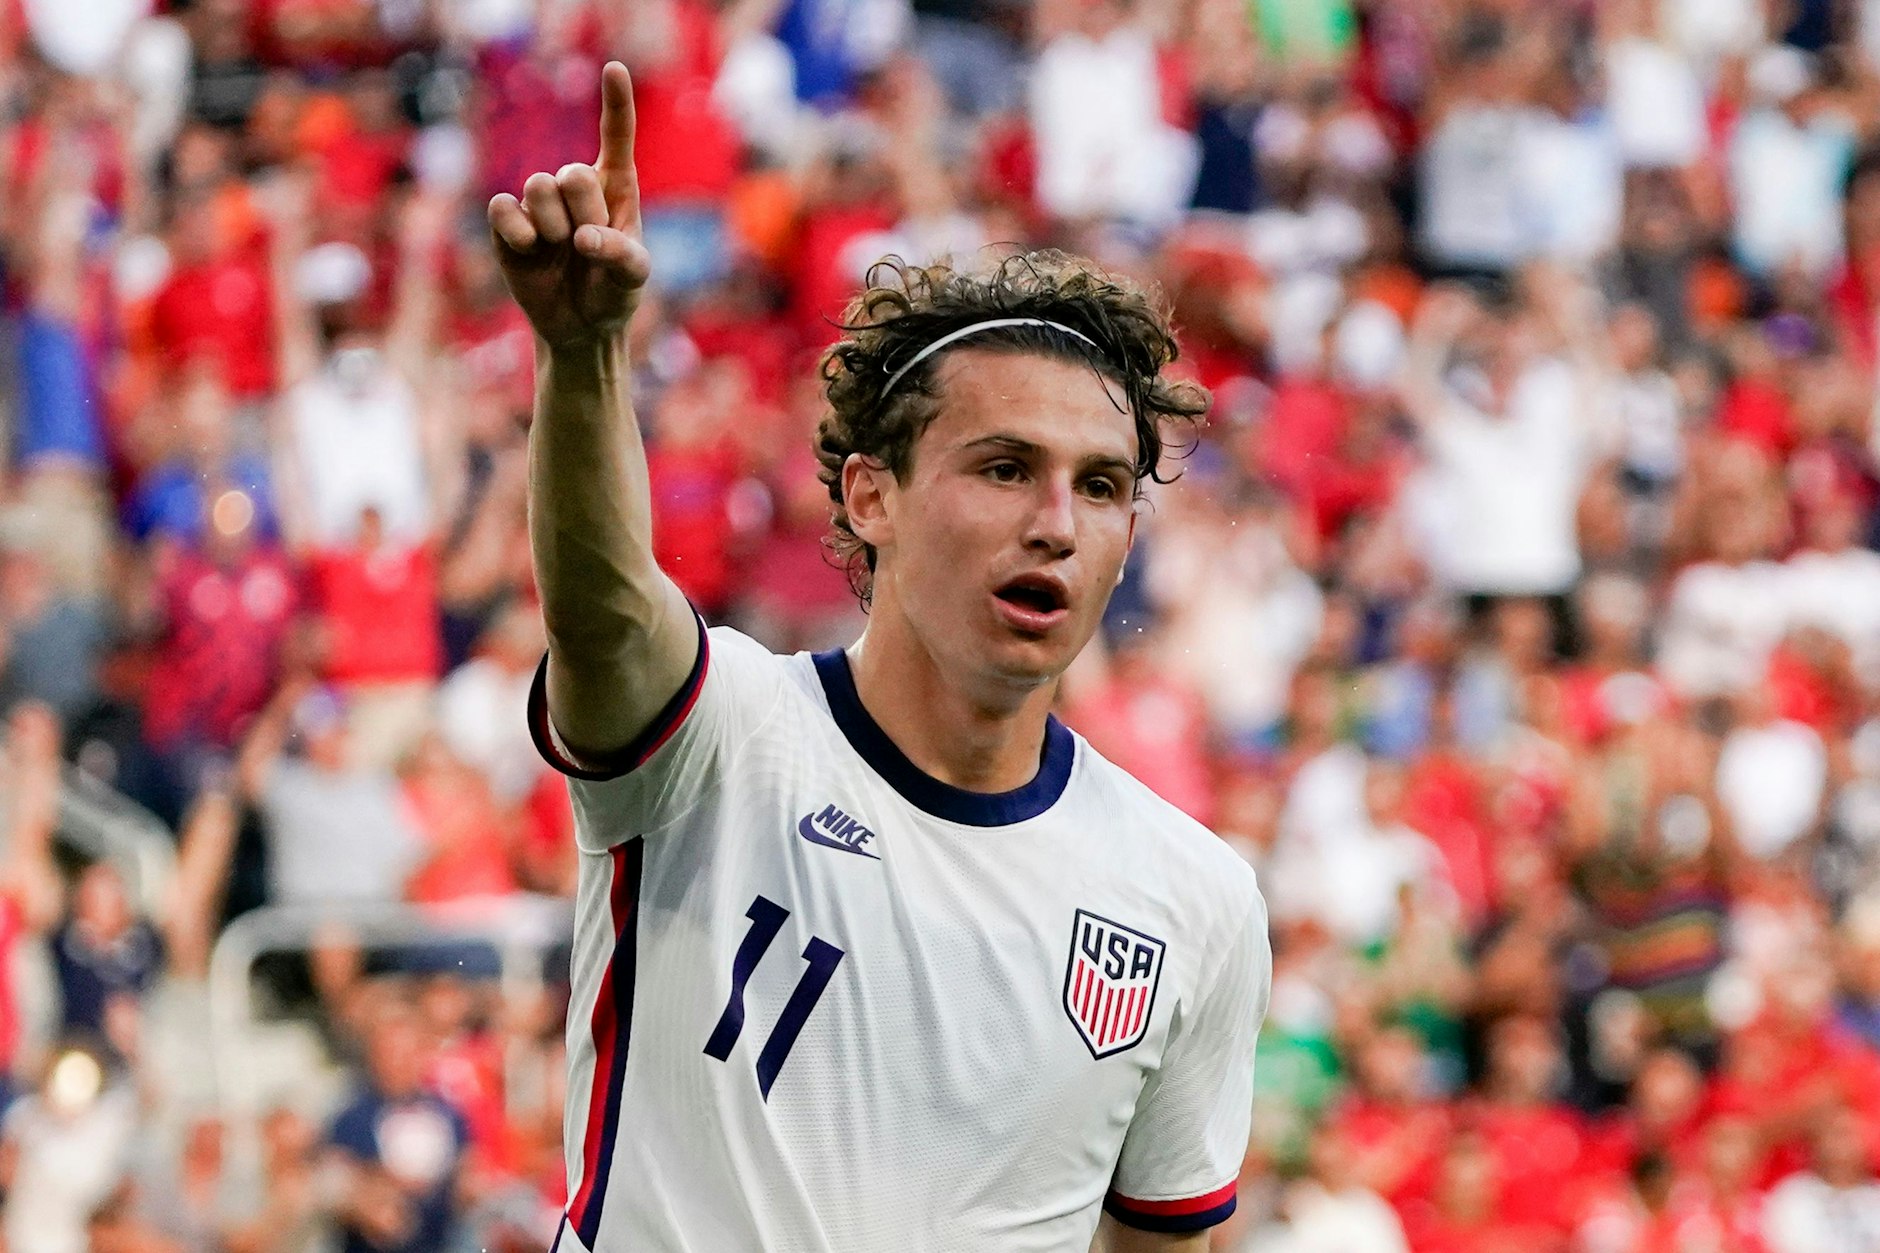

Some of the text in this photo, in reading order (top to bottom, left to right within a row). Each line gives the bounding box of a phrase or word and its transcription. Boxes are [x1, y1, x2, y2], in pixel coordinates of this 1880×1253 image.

[814, 803, 875, 852] NIKE
[1082, 922, 1155, 980] USA
[702, 894, 845, 1104] 11
